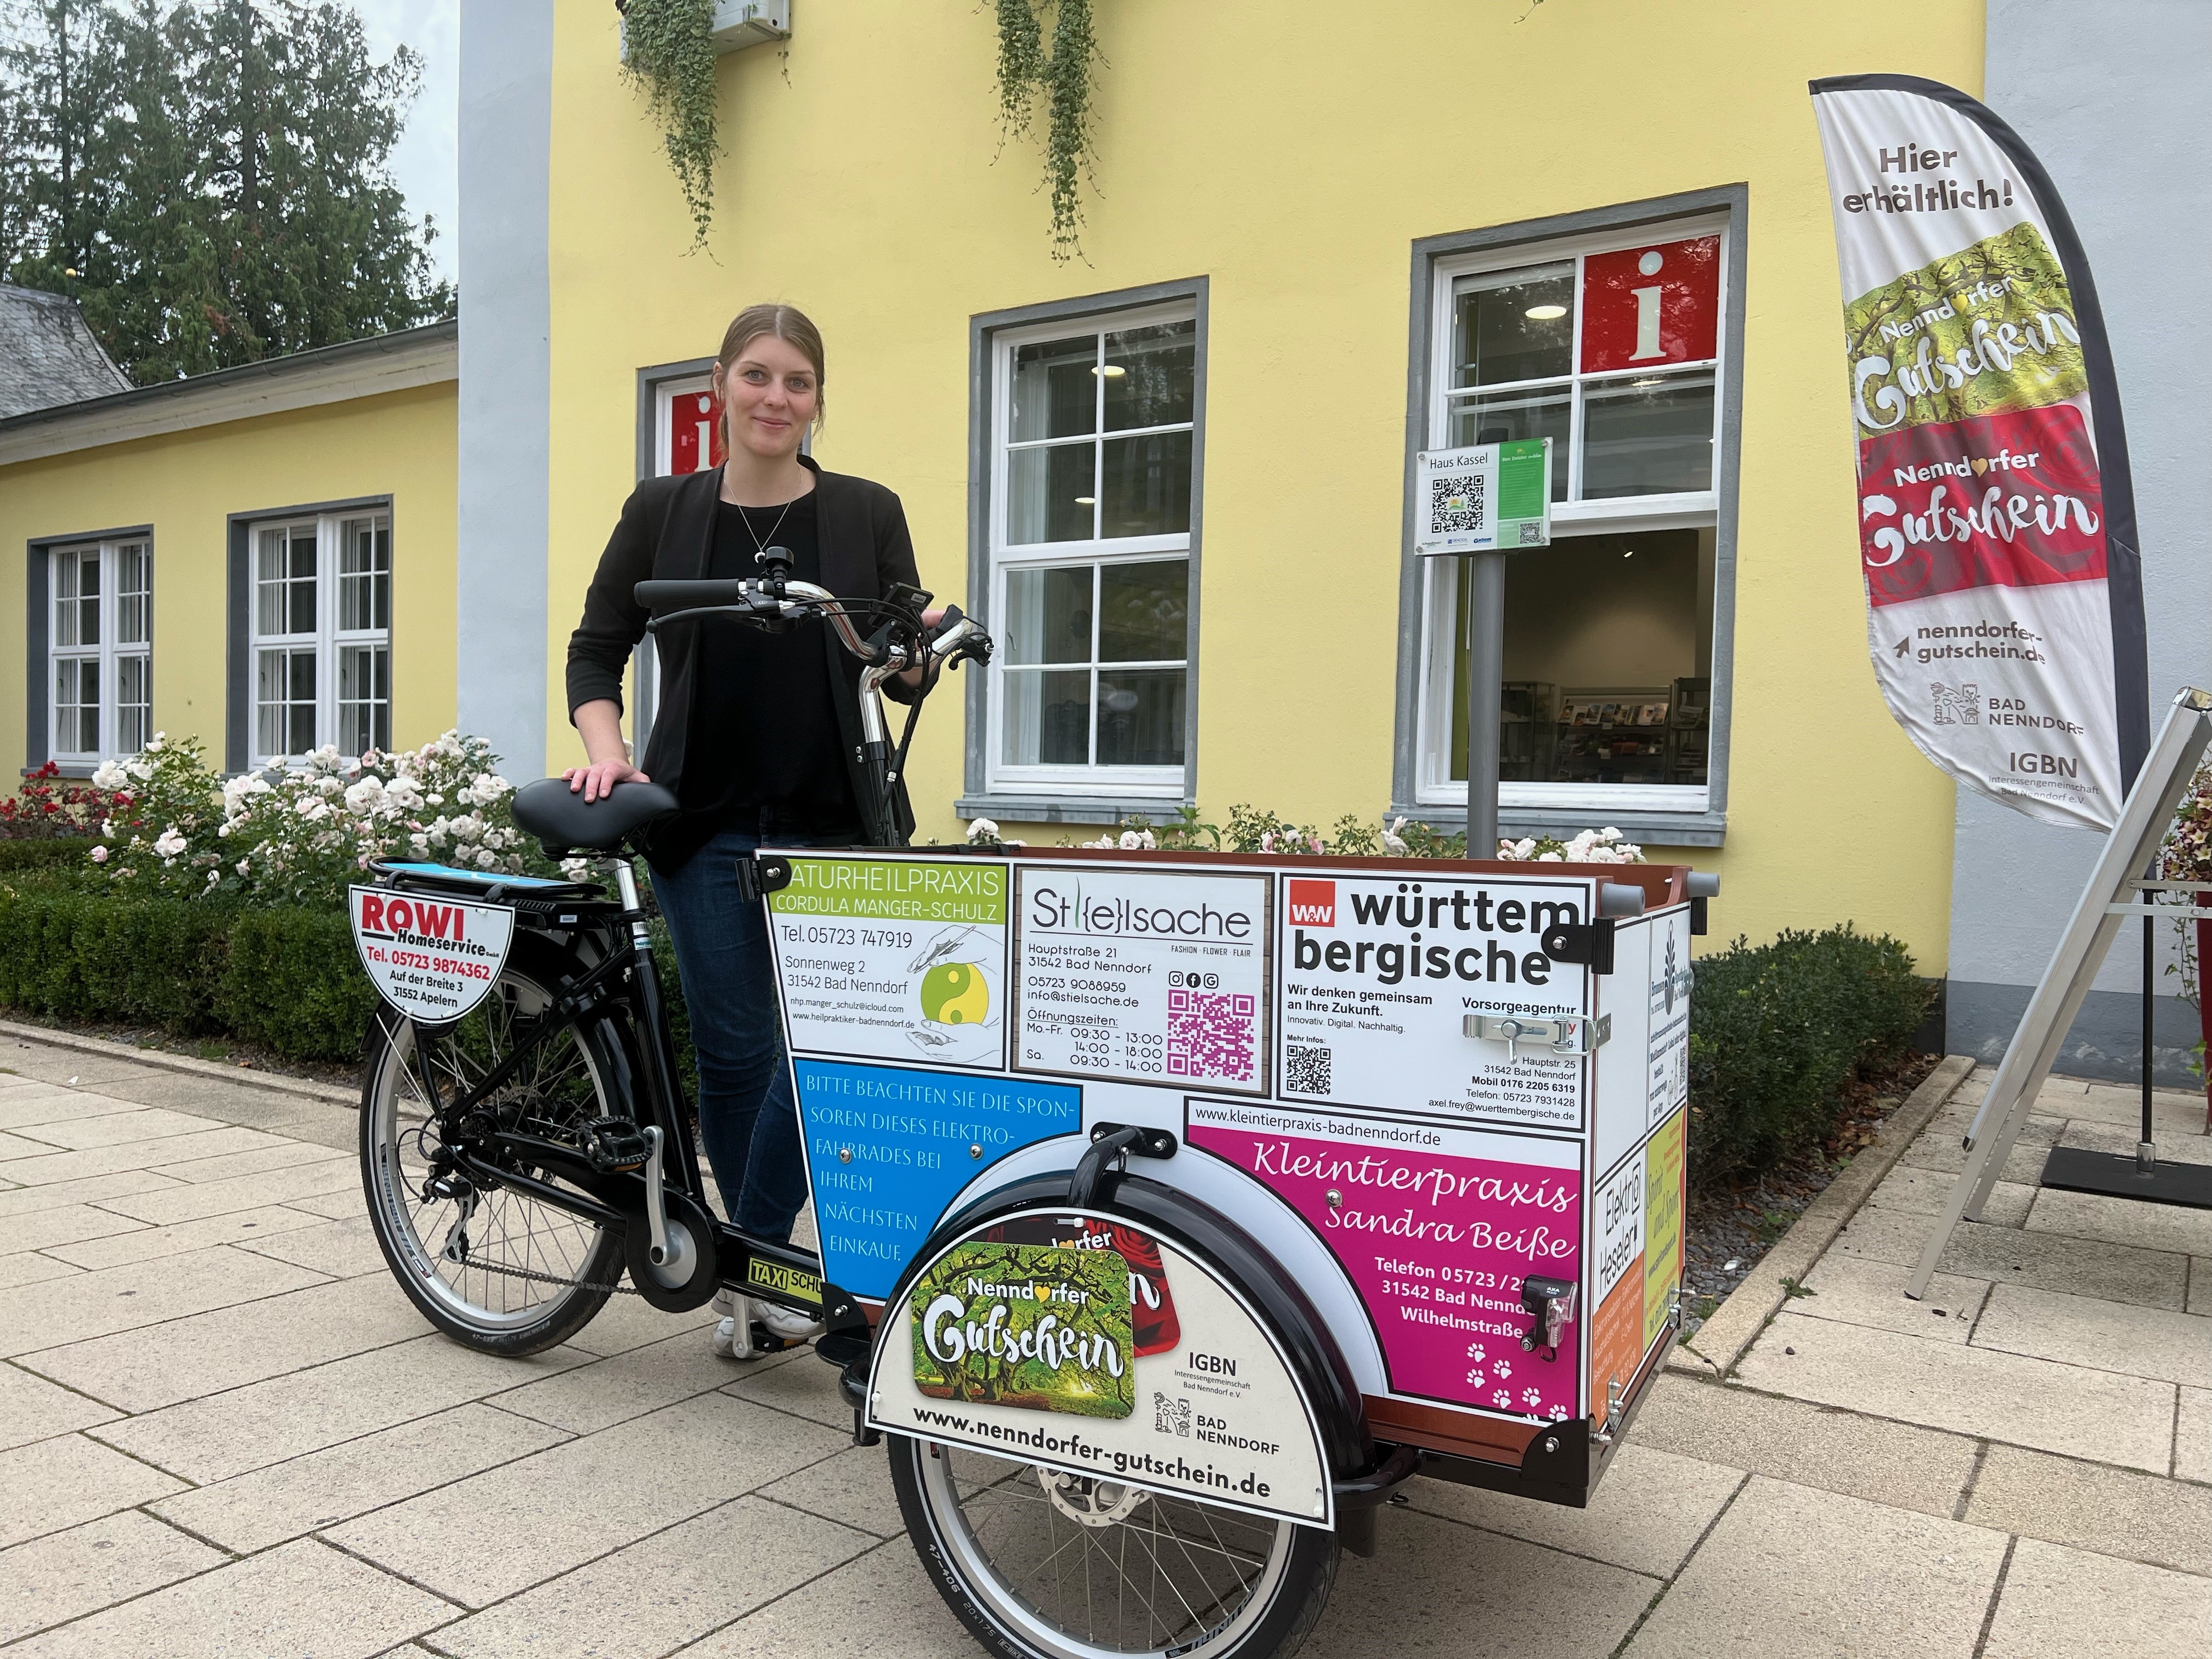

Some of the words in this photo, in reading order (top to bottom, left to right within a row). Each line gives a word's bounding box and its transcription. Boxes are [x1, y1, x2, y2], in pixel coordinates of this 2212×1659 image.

[1880, 142, 1957, 172] Hier
[1843, 178, 2014, 213] erhältlich!
[1629, 251, 1667, 361] i
[1855, 310, 2080, 429] Gutschein
[1430, 459, 1454, 469] Haus
[1458, 453, 1488, 466] Kassel
[1863, 485, 2099, 567] Gutschein
[1918, 620, 2042, 642] nenndorfer-
[1917, 641, 2045, 664] gutschein.de
[1989, 698, 2025, 710] BAD
[1989, 714, 2084, 736] NENNDORF
[2010, 752, 2078, 778] IGBN
[1989, 776, 2100, 795] Interessengemeinschaft
[2021, 789, 2066, 802] Nenndorf
[789, 865, 999, 896] ATURHEILPRAXIS
[362, 895, 464, 941] ROWI
[776, 895, 849, 914] CORDULA
[854, 898, 997, 921] MANGER-SCHULZ
[1351, 883, 1579, 934] württem
[398, 928, 486, 956] Homeservice
[781, 924, 804, 943] Tel.
[808, 927, 855, 945] 05723
[861, 929, 912, 948] 747919
[1029, 944, 1100, 957] Hauptstraße
[1106, 948, 1117, 958] 21
[1171, 945, 1197, 954] FASHION
[1203, 946, 1227, 956] FLOWER
[1233, 949, 1251, 957] FLAIR
[1295, 929, 1551, 985] bergische
[366, 946, 388, 963] Tel.
[392, 951, 429, 969] 05723
[433, 957, 489, 980] 9874362
[786, 956, 855, 974] Sonnenweg
[858, 961, 865, 973] 2
[1029, 957, 1061, 968] 31542
[1066, 958, 1090, 970] Bad
[1094, 961, 1152, 974] Nenndorf
[390, 970, 405, 981] Auf
[409, 973, 423, 985] der
[427, 977, 455, 991] Breite
[458, 982, 462, 992] 3
[788, 975, 821, 989] 31542
[825, 977, 847, 990] Bad
[850, 979, 908, 995] Nenndorf
[1028, 977, 1065, 988] 05723
[1071, 979, 1126, 992] 9088959
[394, 986, 418, 1000] 31552
[420, 992, 458, 1008] Apelern
[791, 997, 904, 1013] nhp.manger_schulz@icloud.com
[1028, 990, 1139, 1007] info@stielsache.de
[1288, 984, 1308, 996] Wir
[1311, 986, 1356, 1000] denken
[1359, 990, 1432, 1006] gemeinsam
[1462, 997, 1576, 1015] Vorsorgeagentur
[1028, 1006, 1118, 1027] Öffnungszeiten:
[1288, 1002, 1302, 1011] an
[1306, 1000, 1329, 1013] Ihre
[1332, 1003, 1383, 1017] Zukunft.
[793, 1012, 915, 1029] www.heilpraktiker-badnenndorf.de
[1288, 1015, 1325, 1026] Innovativ.
[1328, 1018, 1356, 1030] Digital.
[1358, 1021, 1406, 1034] Nachhaltig.
[1027, 1023, 1063, 1035] Mo.-Fr.
[1070, 1028, 1110, 1040] 09:30
[1126, 1032, 1163, 1045] 13:00
[1287, 1035, 1305, 1043] Mehr
[1026, 1050, 1044, 1060] Sa.
[1070, 1054, 1109, 1068] 09:30
[1126, 1060, 1162, 1072] 14:00
[1075, 1042, 1109, 1054] 14:00
[1126, 1047, 1162, 1059] 18:00
[1485, 1064, 1511, 1075] 31542
[1515, 1067, 1532, 1077] Bad
[1534, 1069, 1576, 1081] Nenndorf
[1523, 1057, 1561, 1068] Hauptstr.
[1565, 1060, 1576, 1069] 25
[806, 1075, 850, 1094] BITTE
[857, 1080, 946, 1104] BEACHTEN
[952, 1090, 975, 1107] SIE
[983, 1093, 1010, 1111] DIE
[1017, 1097, 1074, 1118] SPON-
[1472, 1076, 1498, 1087] Mobil
[1501, 1079, 1523, 1089] 0176
[1526, 1080, 1549, 1091] 2205
[1552, 1083, 1575, 1094] 6319
[1429, 1098, 1574, 1121] axel.frey@wuerttembergische.de
[1466, 1088, 1500, 1100] Telefon:
[1503, 1092, 1532, 1103] 05723
[1534, 1094, 1575, 1108] 7931428
[811, 1107, 866, 1127] SOREN
[872, 1114, 927, 1135] DIESES
[933, 1121, 1014, 1144] ELEKTRO-
[1196, 1108, 1441, 1146] www.kleintierpraxis-badnenndorf.de
[816, 1139, 911, 1165] FAHRRADES
[918, 1150, 940, 1169] BEI
[821, 1171, 872, 1192] IHREM
[1253, 1141, 1578, 1212] Kleintierpraxis
[1647, 1165, 1663, 1215] Spirit
[825, 1201, 917, 1231] NÄCHSTEN
[1666, 1185, 1679, 1228] Sport
[1325, 1206, 1465, 1242] Sandra
[1470, 1222, 1576, 1261] Beiße
[830, 1235, 900, 1261] EINKAUF.
[1600, 1226, 1633, 1295] Heseler
[753, 1262, 787, 1289] TAXI
[791, 1272, 821, 1293] SCHU
[1375, 1256, 1435, 1278] Telefon
[1499, 1275, 1508, 1290] /
[1511, 1277, 1525, 1291] 2
[1383, 1280, 1429, 1299] 31542
[1435, 1288, 1465, 1305] Bad
[1401, 1306, 1523, 1339] Wilhelmstraße
[923, 1293, 1124, 1379] Gutschein
[1190, 1352, 1235, 1376] IGBN
[1175, 1370, 1250, 1390] Interessengemeinschaft
[1197, 1385, 1228, 1396] Nenndorf
[1197, 1415, 1226, 1430] BAD
[913, 1407, 1271, 1499] www.nenndorfer-gutschein.de
[1197, 1429, 1279, 1454] NENNDORF
[929, 1544, 961, 1593] 47-406
